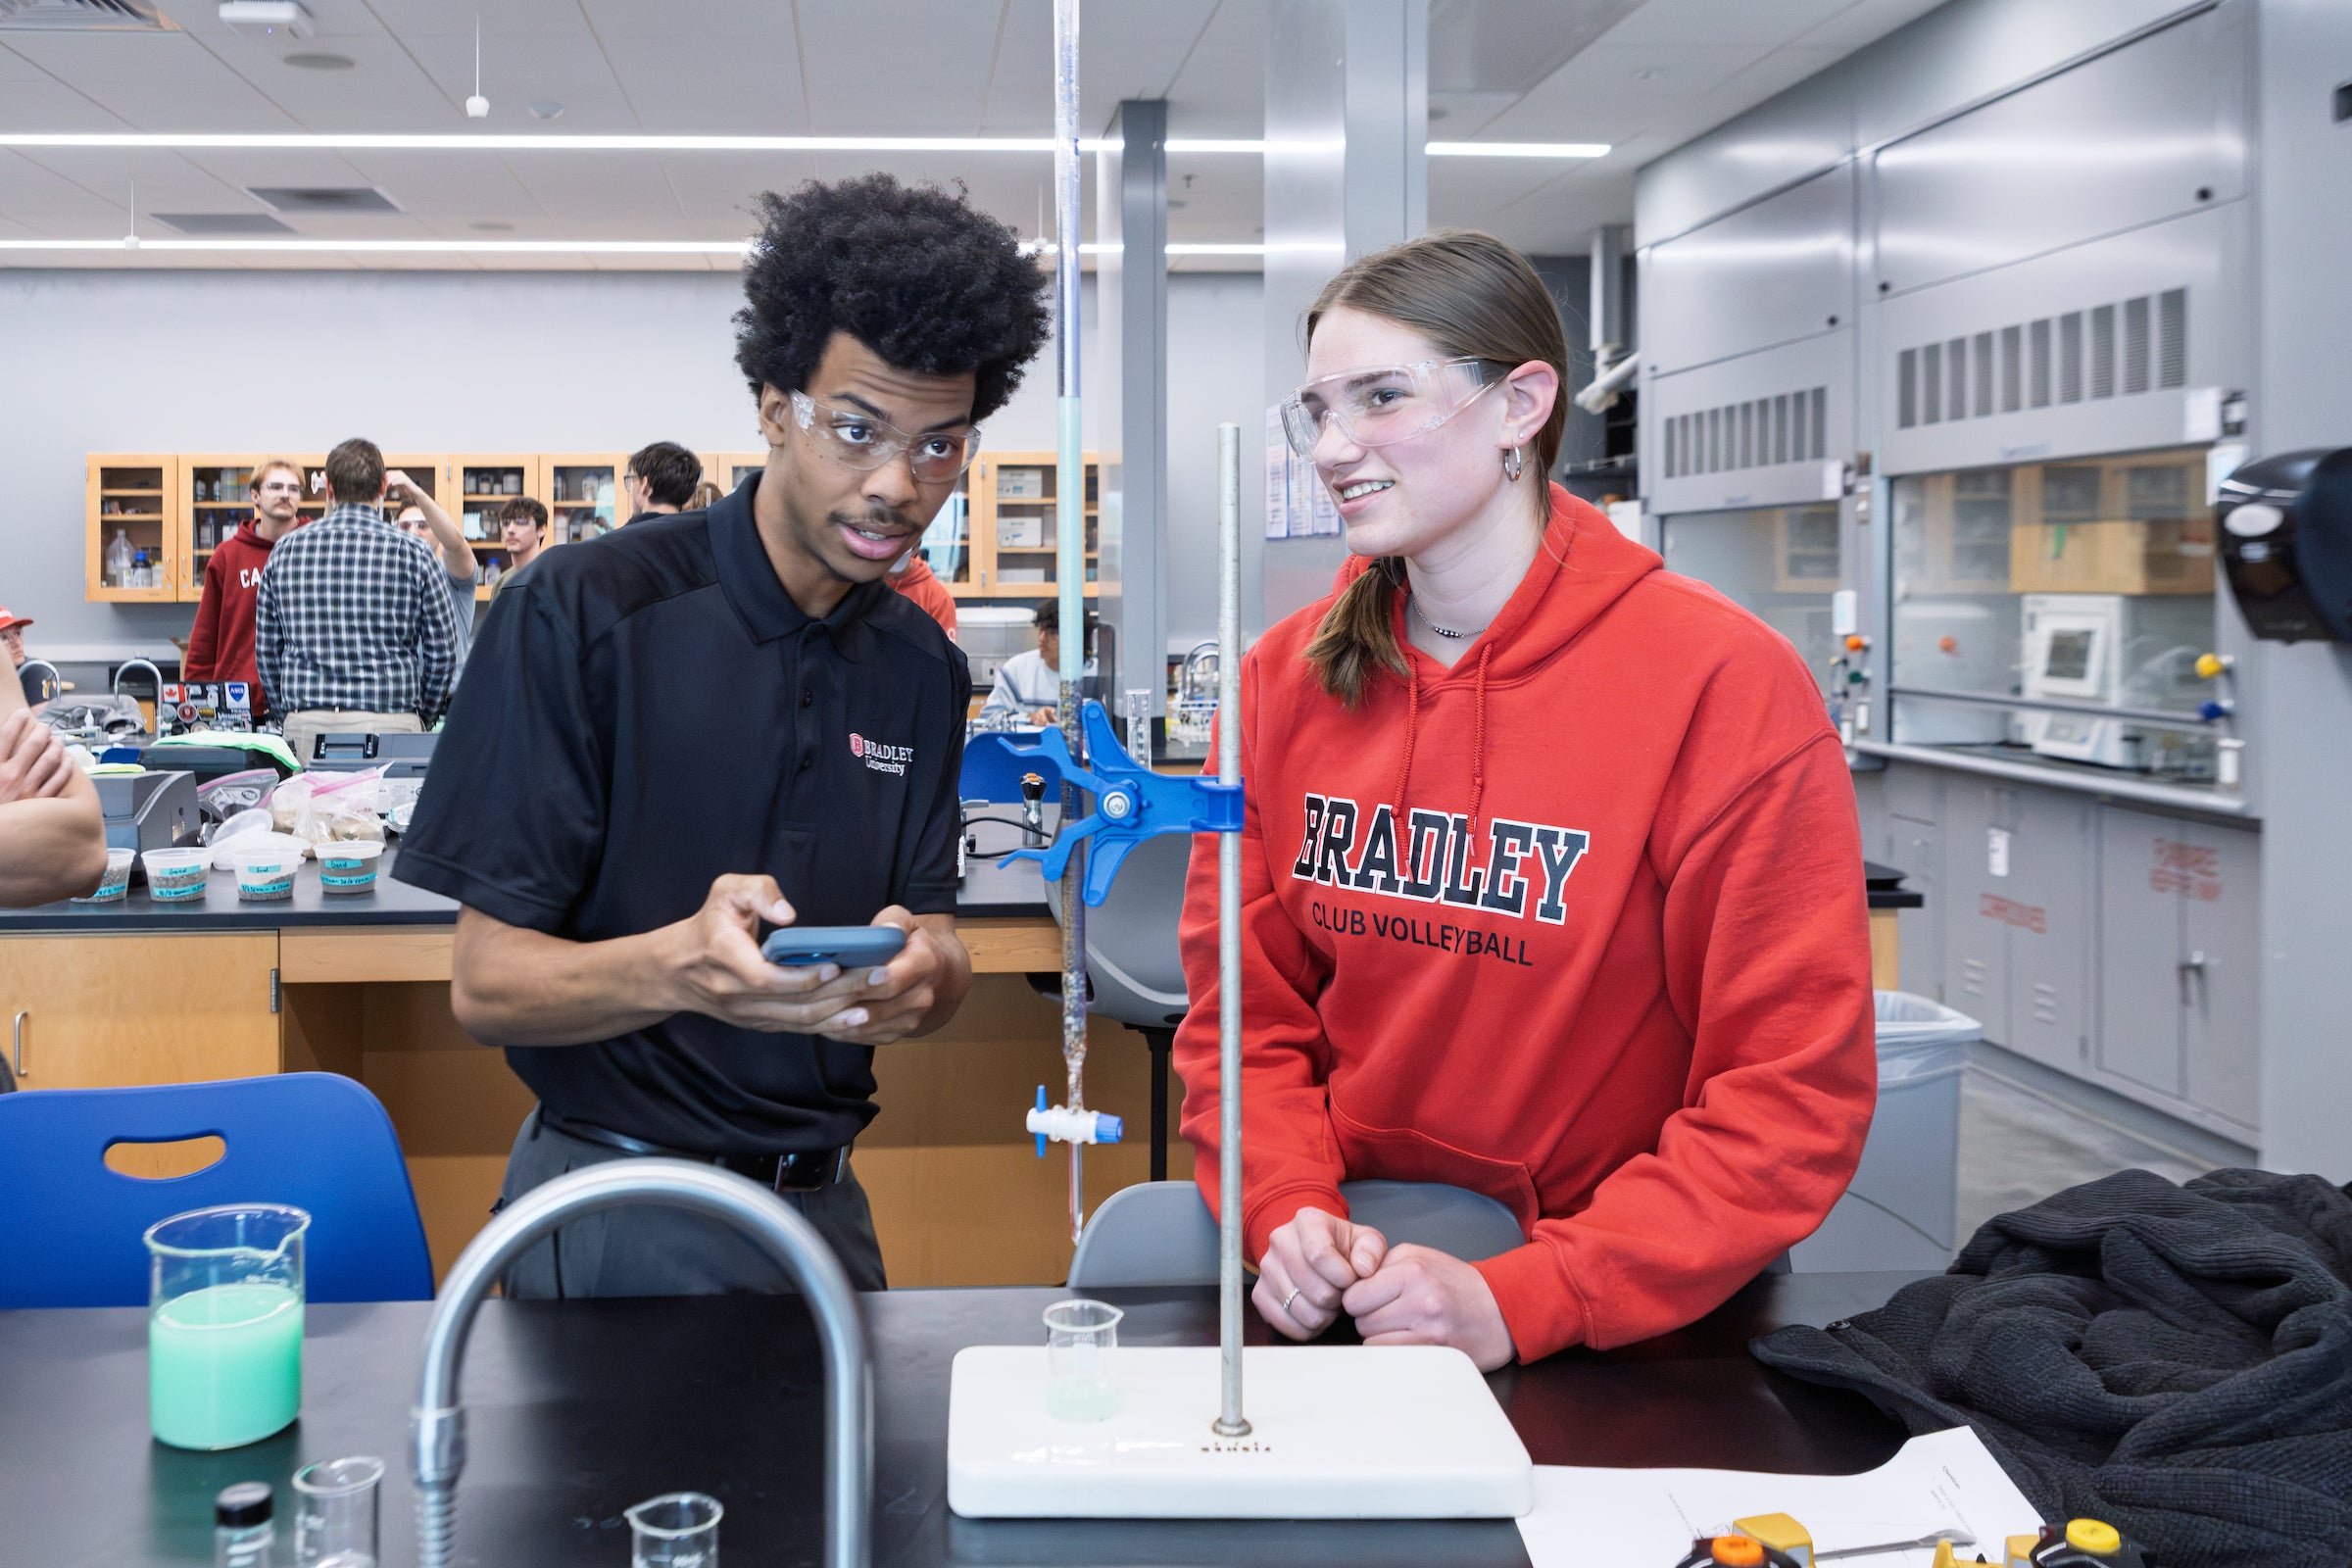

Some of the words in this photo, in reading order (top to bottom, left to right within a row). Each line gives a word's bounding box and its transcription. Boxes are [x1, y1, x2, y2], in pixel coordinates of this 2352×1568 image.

[863, 739, 914, 762] BRADLEY
[864, 755, 906, 777] University
[1292, 792, 1591, 925] BRADLEY
[1312, 902, 1366, 935] CLUB
[1373, 913, 1533, 966] VOLLEYBALL
